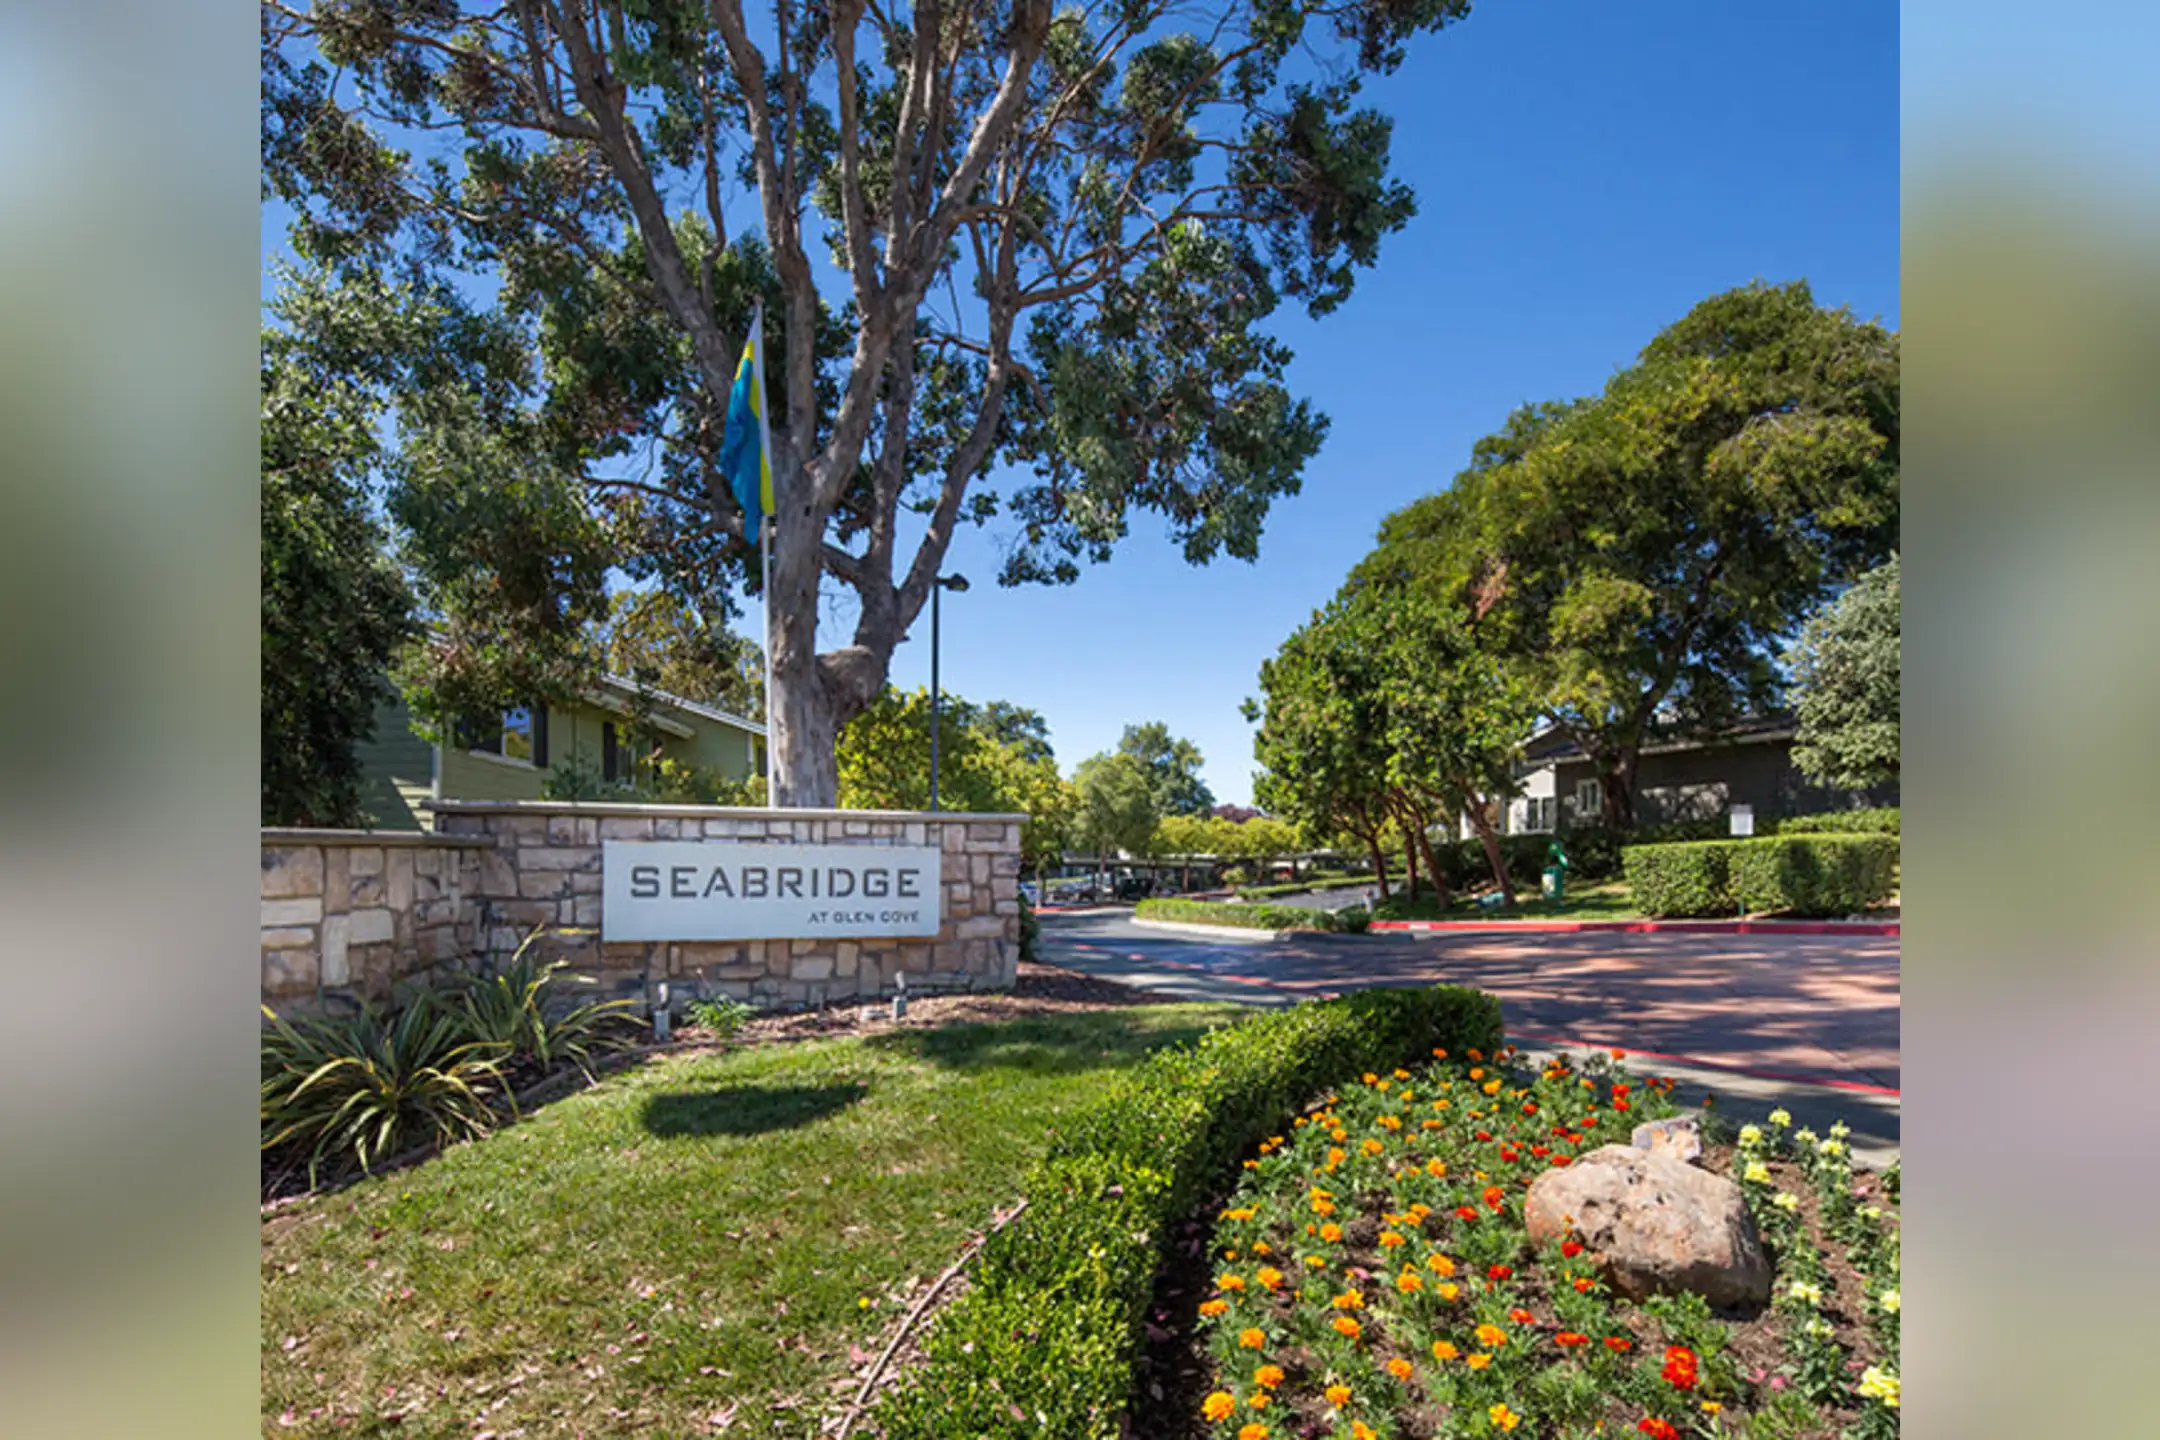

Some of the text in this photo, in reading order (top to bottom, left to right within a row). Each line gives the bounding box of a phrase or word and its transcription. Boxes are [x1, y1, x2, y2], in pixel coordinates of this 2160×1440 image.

[630, 866, 920, 899] SEABRIDGE
[807, 910, 919, 924] AT GLEN COVE
